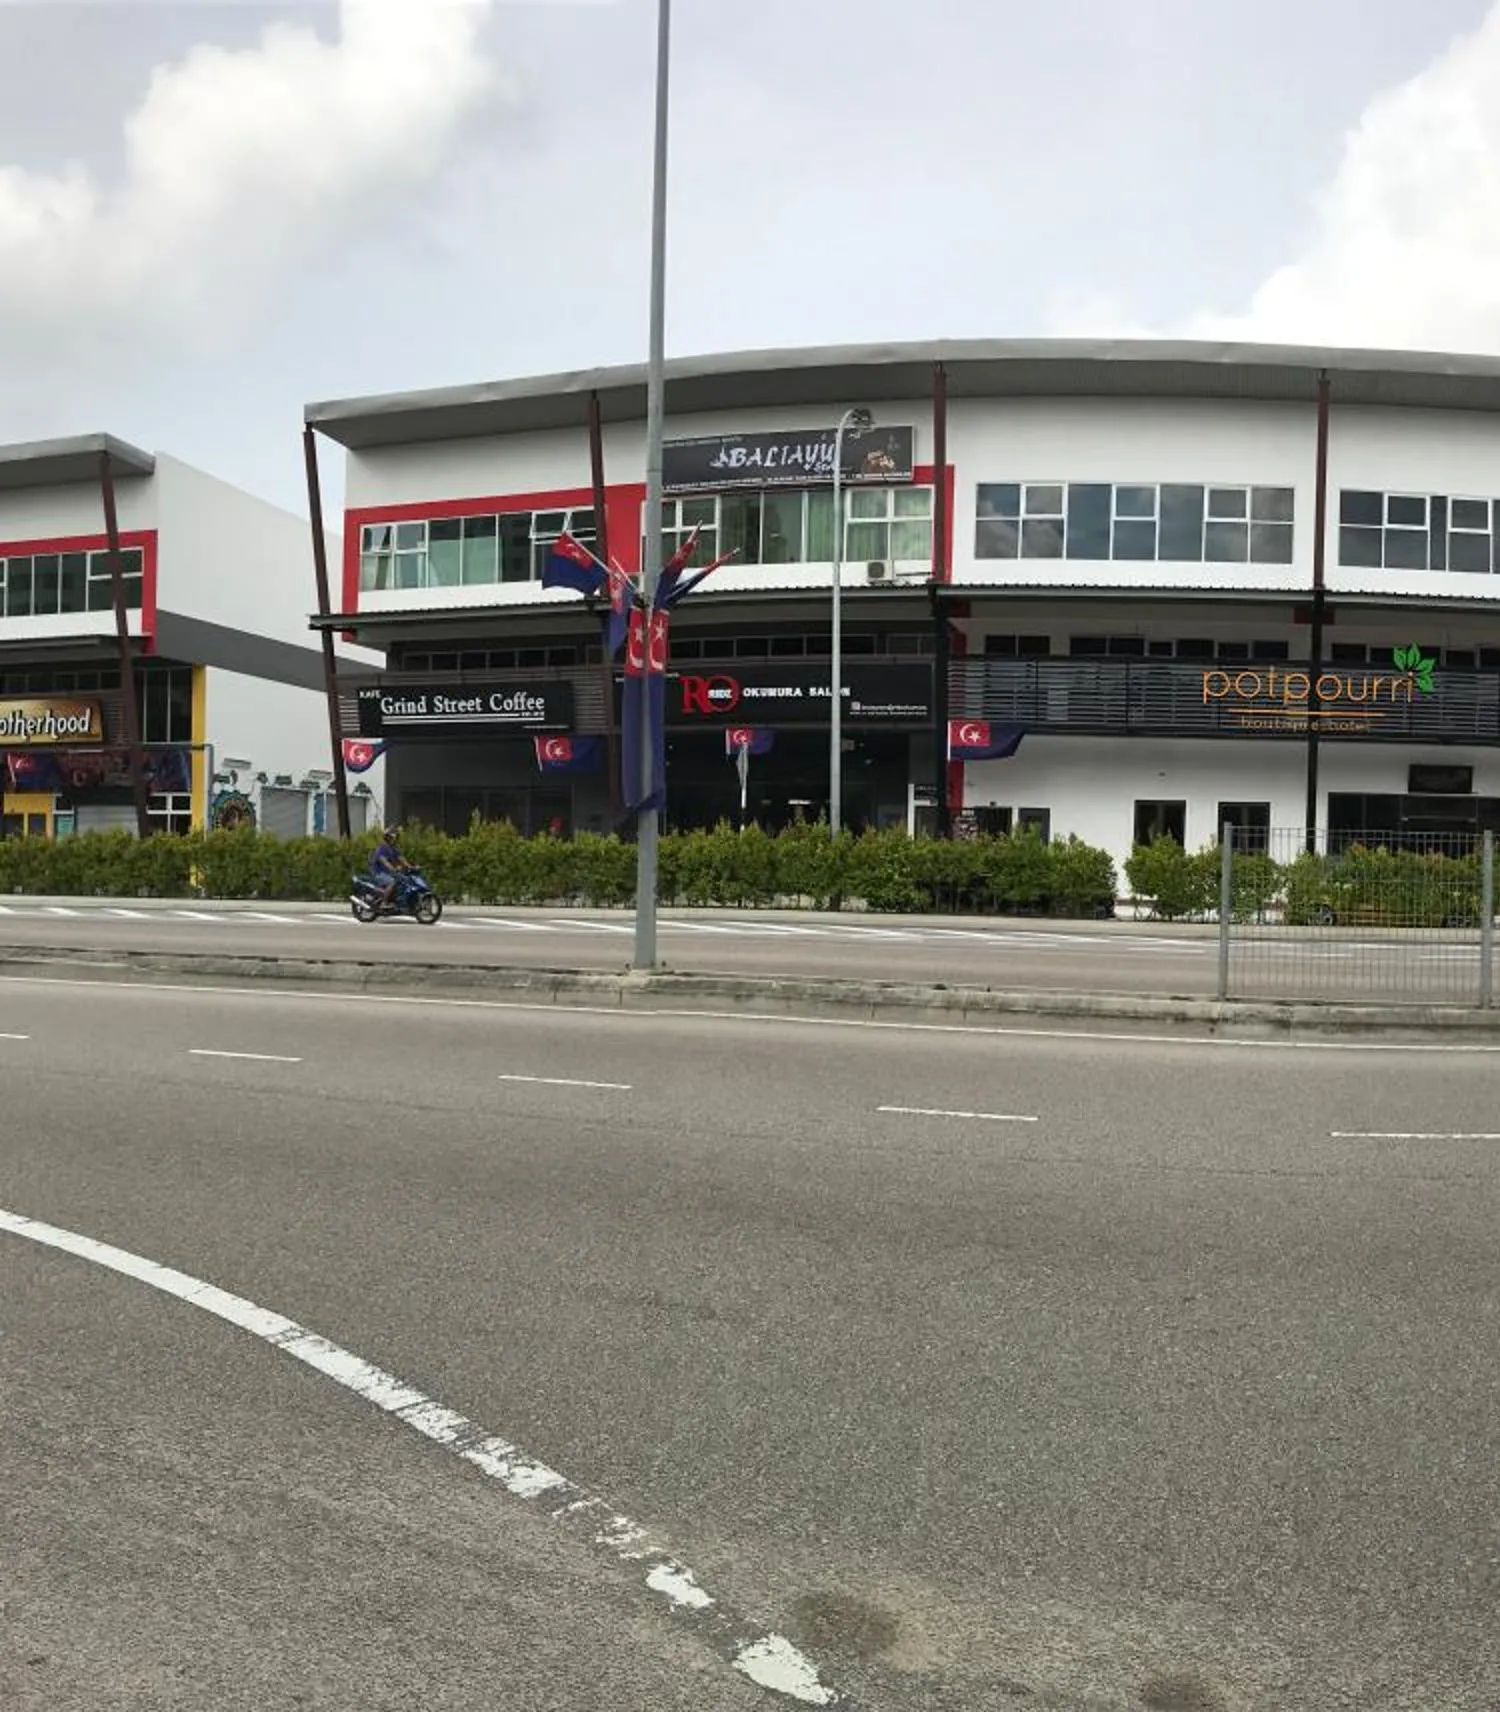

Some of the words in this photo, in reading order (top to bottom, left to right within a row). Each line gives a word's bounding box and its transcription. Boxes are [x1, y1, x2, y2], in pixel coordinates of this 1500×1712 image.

[742, 687, 803, 698] OKUMURA
[809, 687, 851, 698] SALN
[1202, 665, 1414, 705] potpourri
[380, 697, 427, 714] Grind
[433, 695, 482, 713] Street
[489, 691, 545, 712] Coffee
